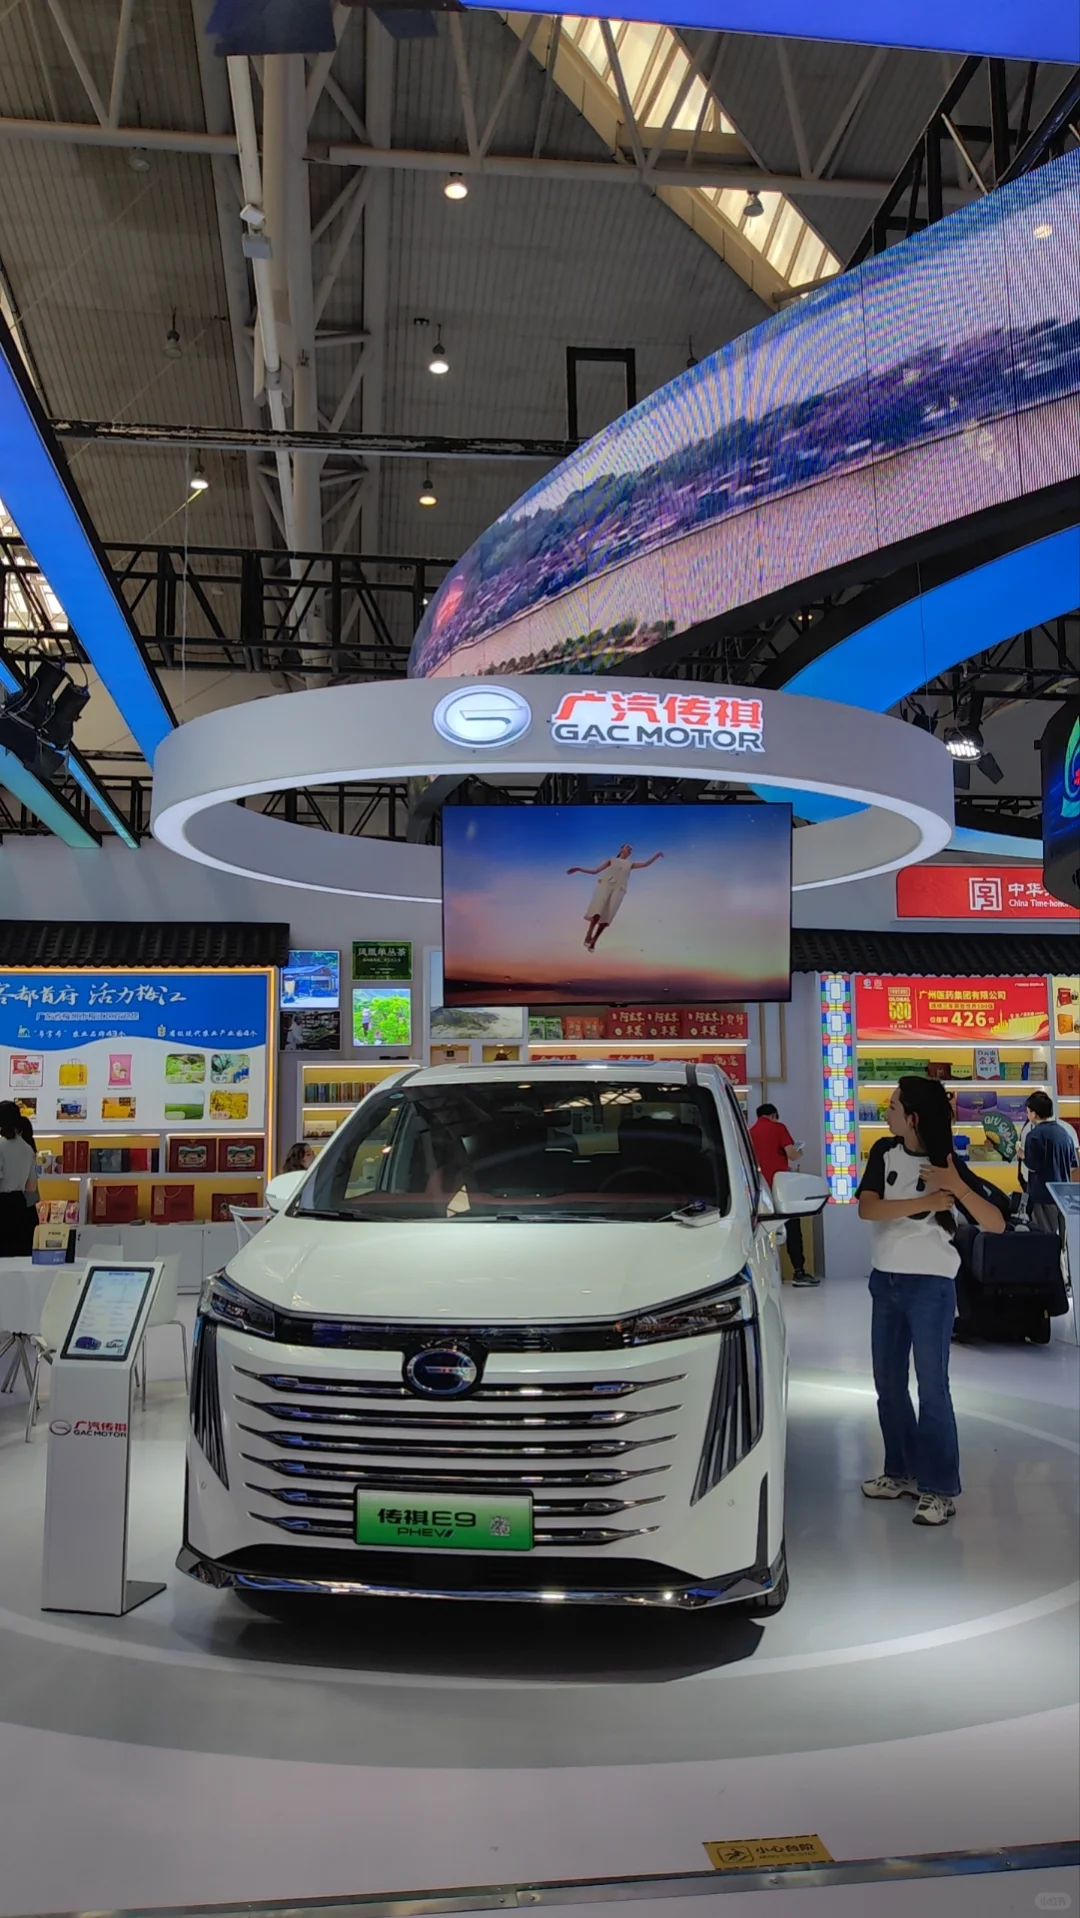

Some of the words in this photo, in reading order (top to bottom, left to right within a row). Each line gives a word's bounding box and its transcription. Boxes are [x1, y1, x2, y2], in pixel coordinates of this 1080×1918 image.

[555, 691, 762, 729] 广汽传祺
[554, 722, 629, 744] GAC
[636, 724, 764, 753] MOTOR
[1008, 882, 1050, 897] 中华
[1008, 899, 1029, 907] China
[88, 982, 187, 1006] 活力梅江
[919, 990, 1006, 1000] 广州医药集团有限公司
[888, 1002, 912, 1020] 500
[951, 1011, 987, 1027] 426
[74, 1420, 127, 1432] 广汽传祺
[377, 1508, 476, 1527] 传祺E9
[756, 1844, 814, 1854] 小心台阶
